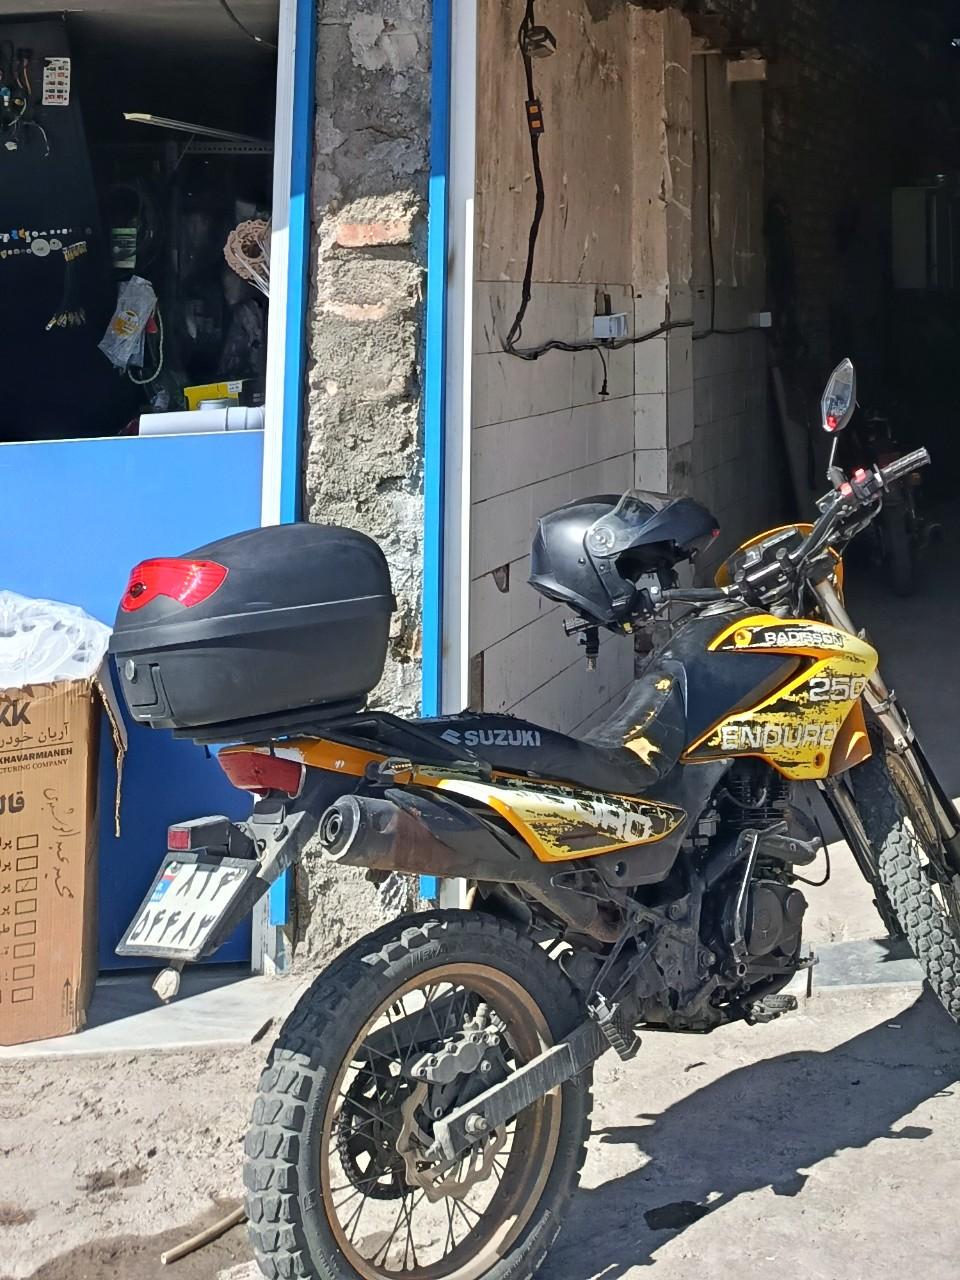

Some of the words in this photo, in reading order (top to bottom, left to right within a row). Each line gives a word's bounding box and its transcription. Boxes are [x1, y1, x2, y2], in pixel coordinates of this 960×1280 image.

[764, 630, 845, 647] BADISSON
[808, 676, 867, 701] 250
[38, 722, 70, 743] آریان
[464, 729, 542, 747] SUZUKI
[720, 723, 838, 751] ENDURO
[32, 758, 68, 770] COMPANY
